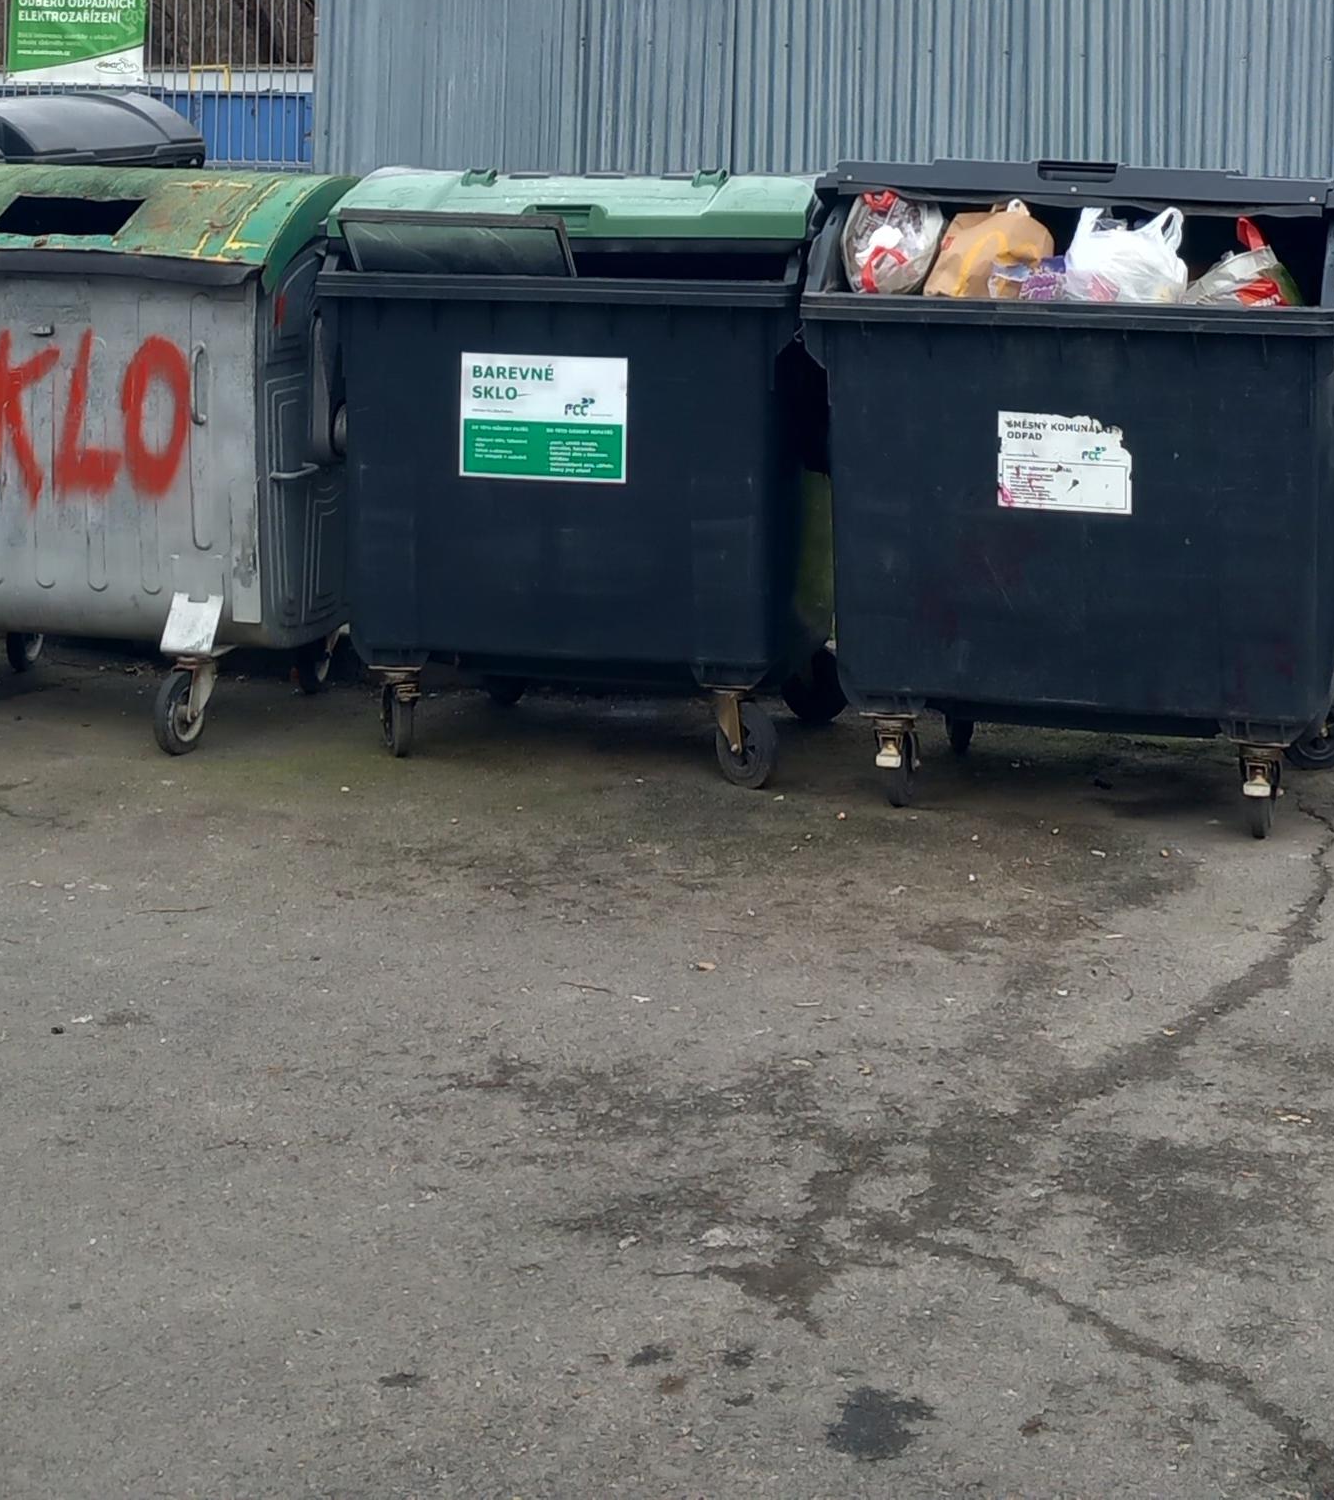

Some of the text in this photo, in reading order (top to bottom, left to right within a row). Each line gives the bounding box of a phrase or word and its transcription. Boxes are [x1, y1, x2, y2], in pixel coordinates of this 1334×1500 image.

[18, 9, 121, 24] ELEKTROZAŘÍZENÍ
[472, 364, 554, 381] BAREVNÉ
[472, 386, 518, 401] SKLO
